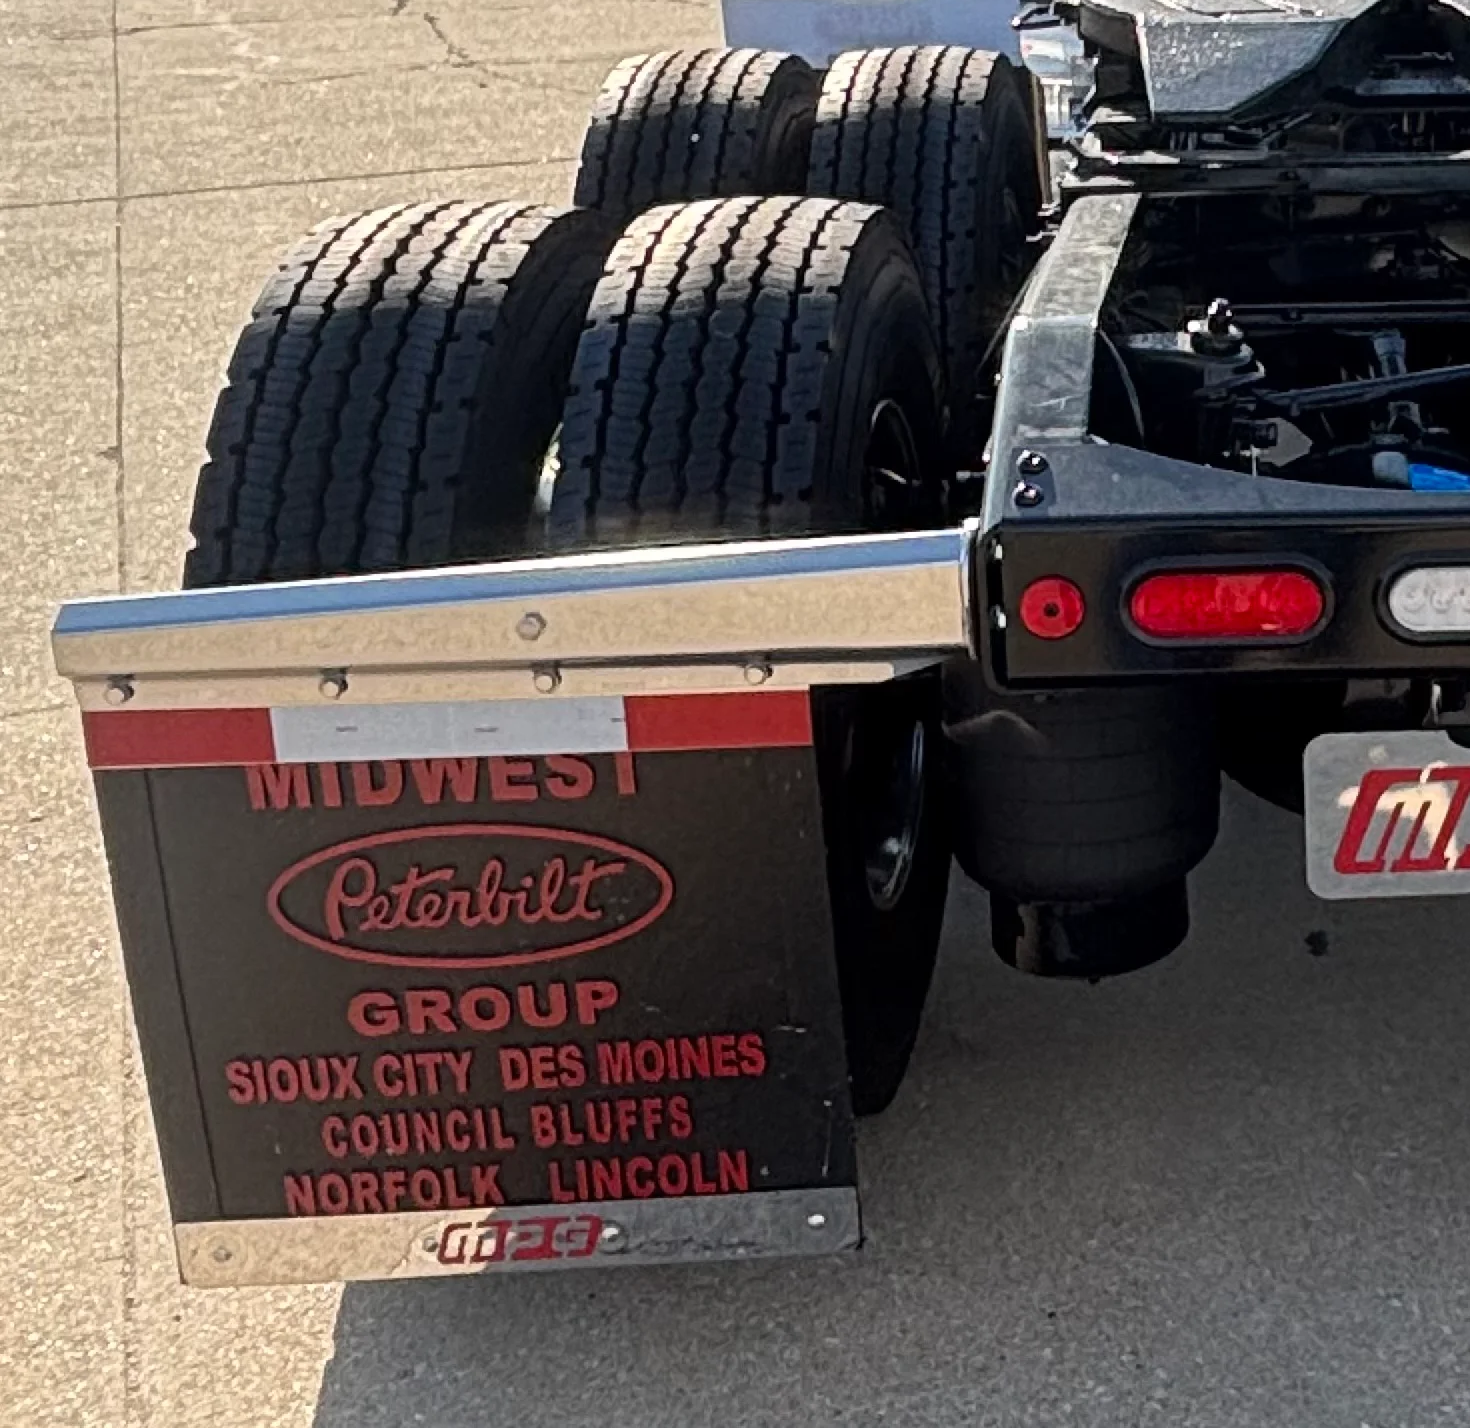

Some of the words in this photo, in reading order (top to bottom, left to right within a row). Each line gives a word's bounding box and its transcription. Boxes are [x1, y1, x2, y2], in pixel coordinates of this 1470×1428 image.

[324, 855, 628, 941] Peterbilt
[346, 980, 619, 1038] GROUP
[223, 1055, 364, 1105] SIOUX
[372, 1050, 473, 1097] CITY
[499, 1045, 586, 1092] DES
[600, 1033, 768, 1086] MOINES
[321, 1108, 515, 1159] COUNCIL
[530, 1095, 693, 1148] BLUFFS
[283, 1164, 506, 1216] NORFOLK
[548, 1150, 750, 1205] LINCOLN
